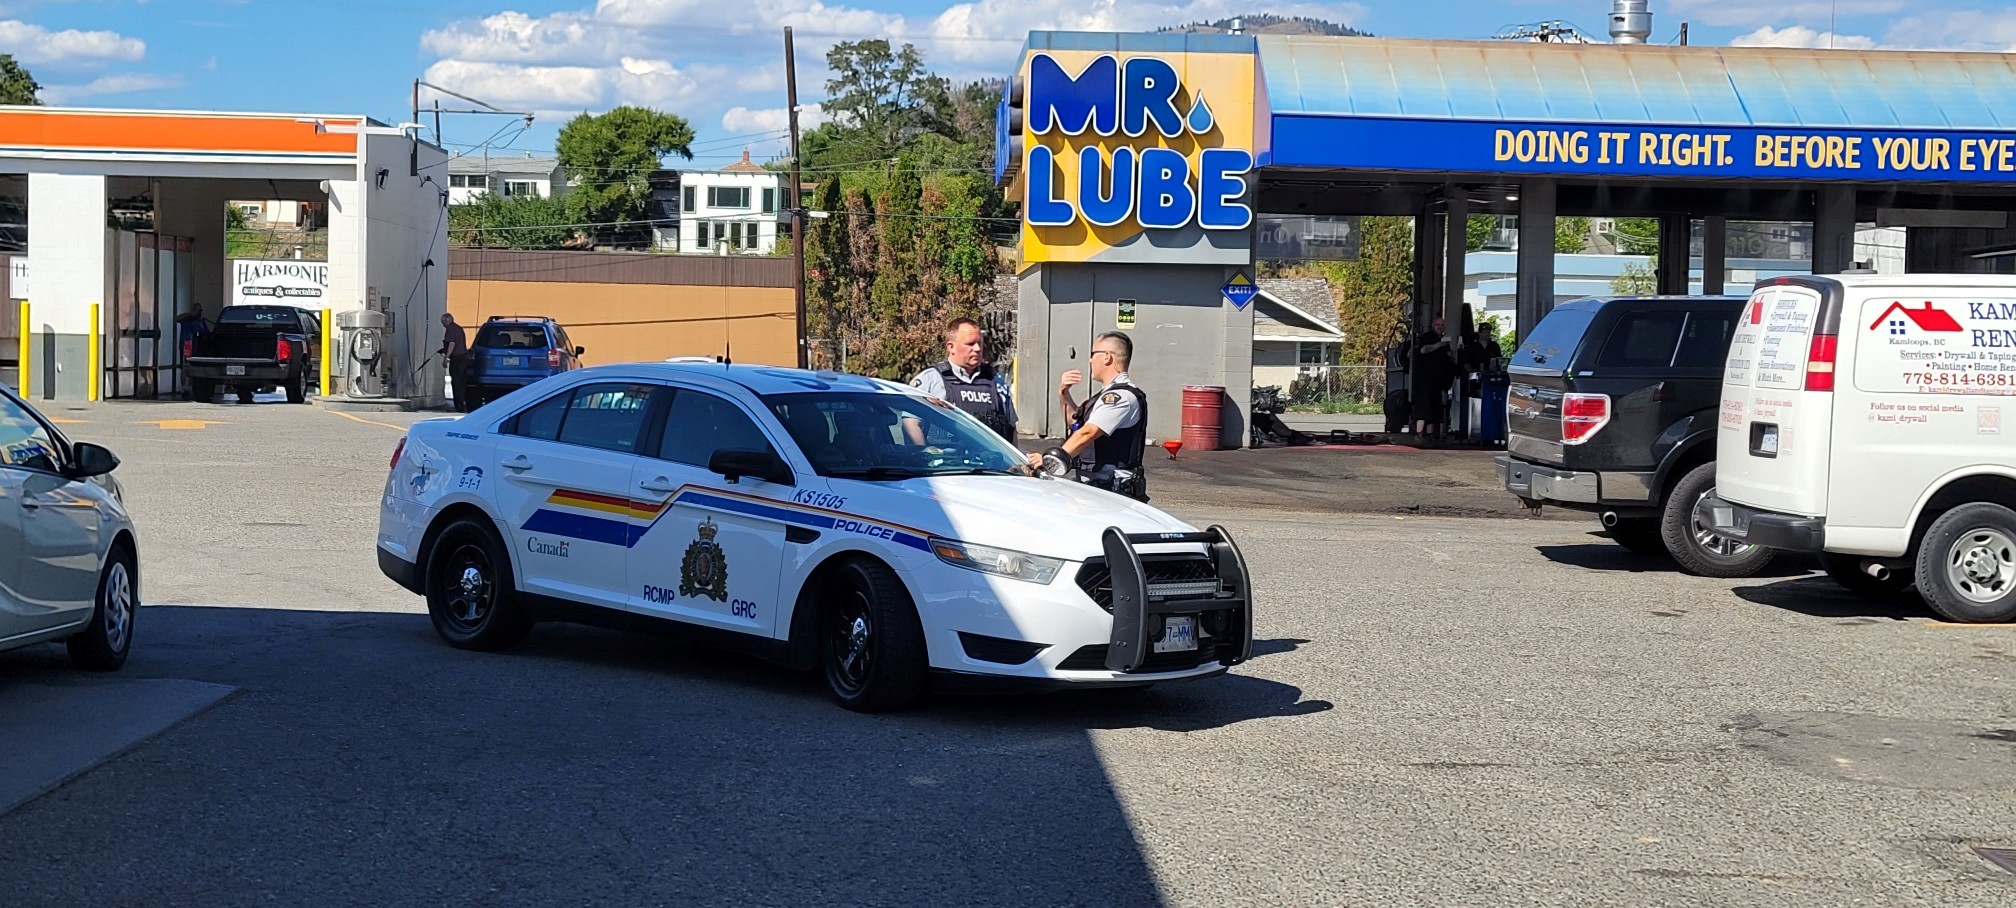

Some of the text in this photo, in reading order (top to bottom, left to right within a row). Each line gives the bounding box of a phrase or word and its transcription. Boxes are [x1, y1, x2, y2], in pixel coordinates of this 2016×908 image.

[1494, 129, 2016, 172] DOING IT RIGHT. BEFORE YOUR EYE
[1027, 144, 1254, 230] LUBE
[238, 263, 328, 287] HARMONIE
[243, 287, 273, 296] antiques
[274, 286, 284, 297] &
[1968, 302, 2016, 320] KAM
[1889, 338, 1946, 347] Kamloops, BC
[1971, 329, 2016, 348] REN
[1900, 350, 2016, 363] Services: Drywall & Taping
[1931, 362, 2016, 373] Painting Home Ren
[1903, 372, 2016, 386] 778-814-6381
[960, 390, 993, 404] POLICE
[1870, 402, 1896, 411] Follow
[1919, 404, 1940, 412] social
[458, 476, 481, 490] 9-1-1
[793, 488, 848, 509] KS1505
[834, 519, 895, 540] POLICE
[527, 536, 569, 558] Canada
[643, 584, 757, 619] RCMP GRC
